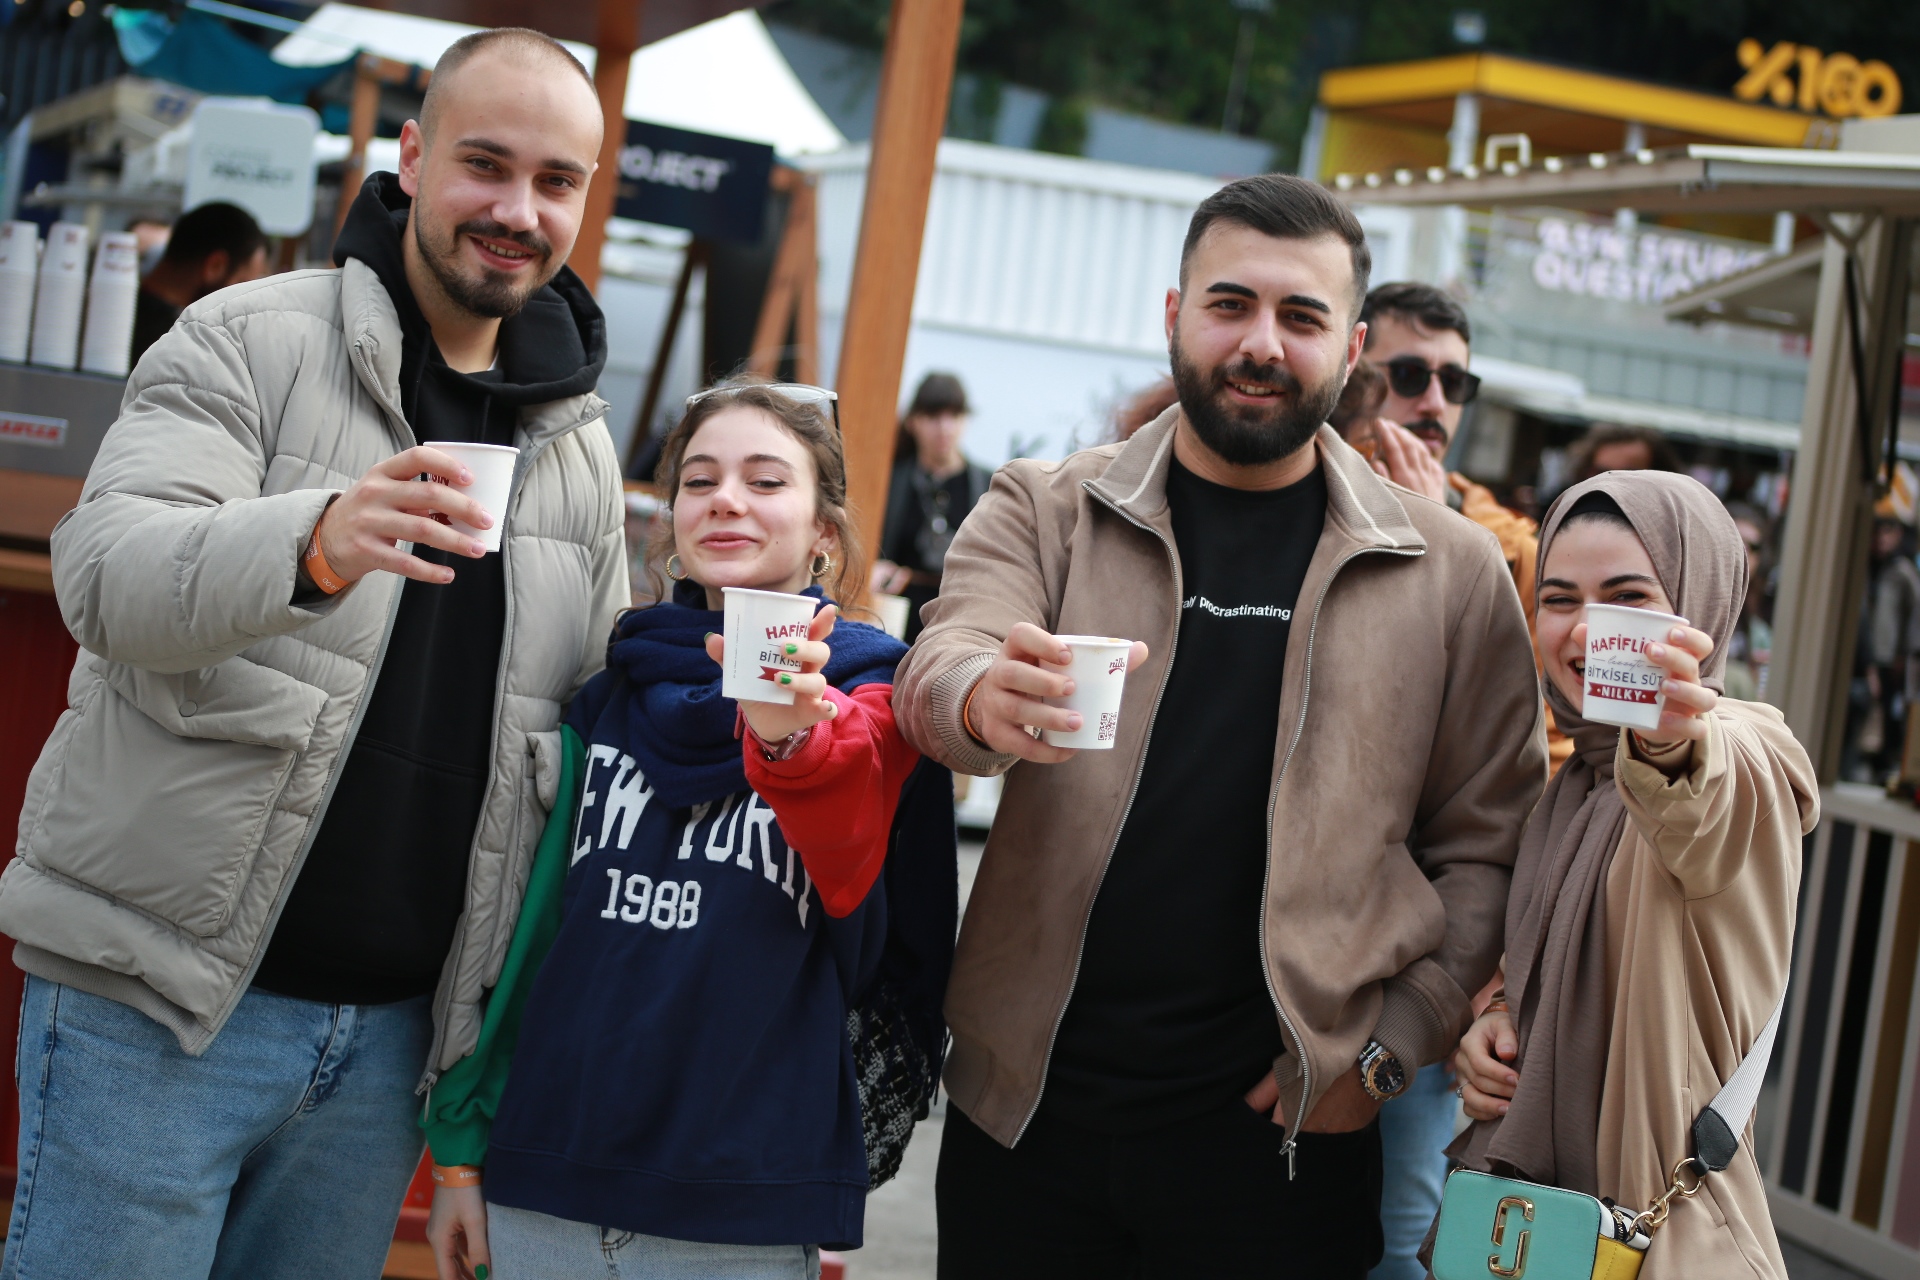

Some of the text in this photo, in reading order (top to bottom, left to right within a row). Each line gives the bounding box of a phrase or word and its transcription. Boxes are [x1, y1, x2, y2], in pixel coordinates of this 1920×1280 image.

[1200, 597, 1291, 621] procrastinating
[1591, 633, 1656, 654] HAFİFLİ
[677, 790, 813, 930] YOR
[600, 867, 702, 931] 1988
